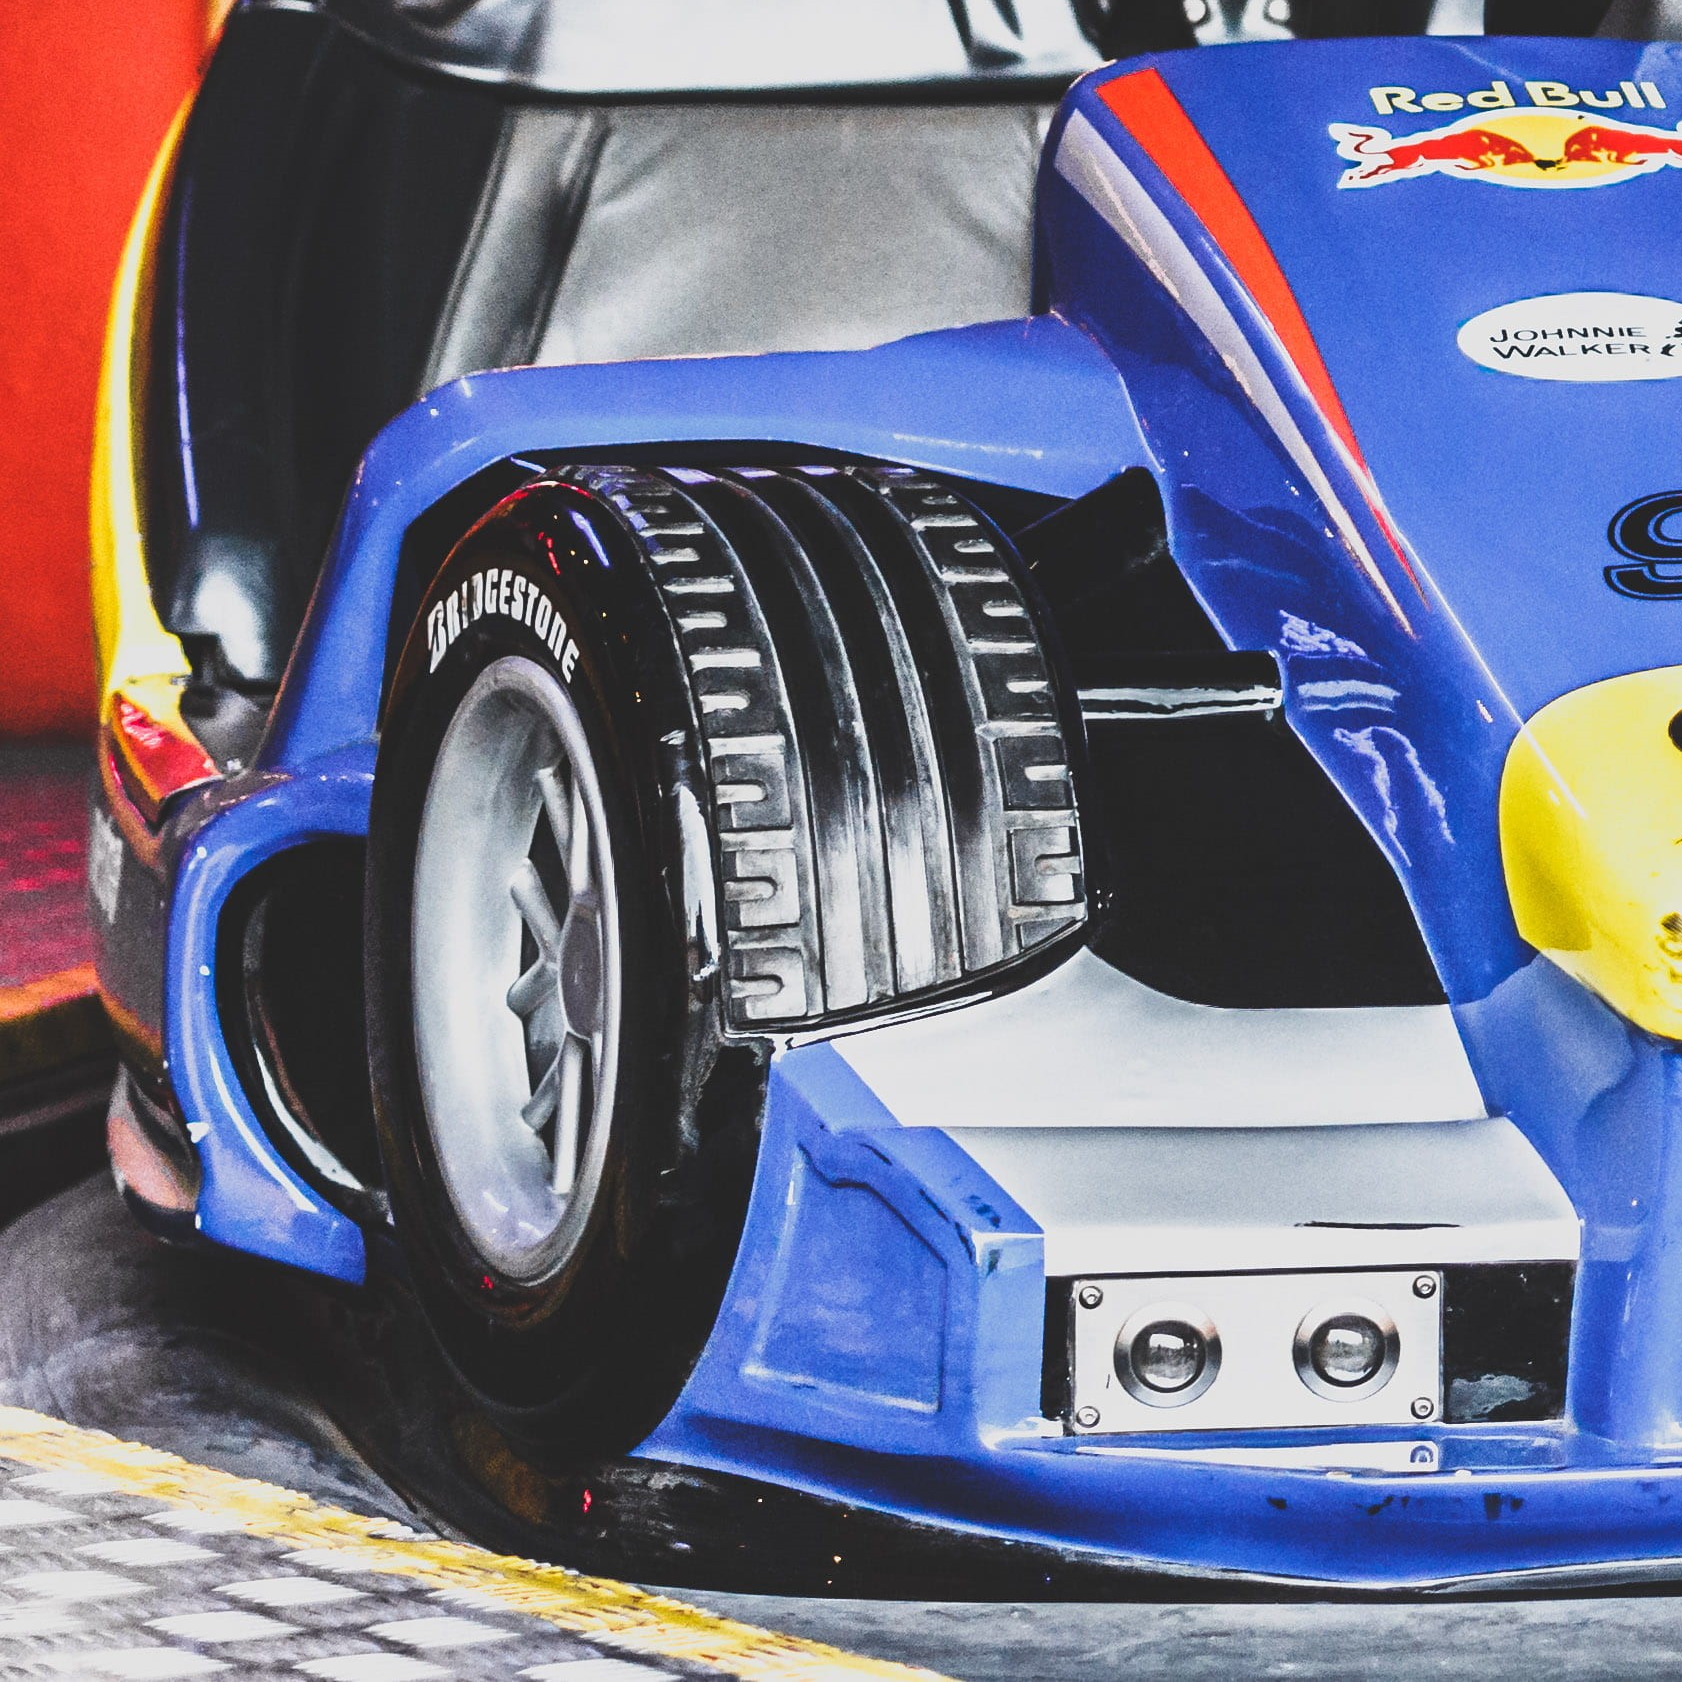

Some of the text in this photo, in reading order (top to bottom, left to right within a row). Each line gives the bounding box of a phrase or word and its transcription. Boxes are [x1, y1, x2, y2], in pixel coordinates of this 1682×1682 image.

[1369, 81, 1667, 115] Red Bull
[1489, 326, 1648, 343] JOHNNIE
[1492, 343, 1652, 359] WALKER
[426, 567, 580, 685] BRIDGESTONE
